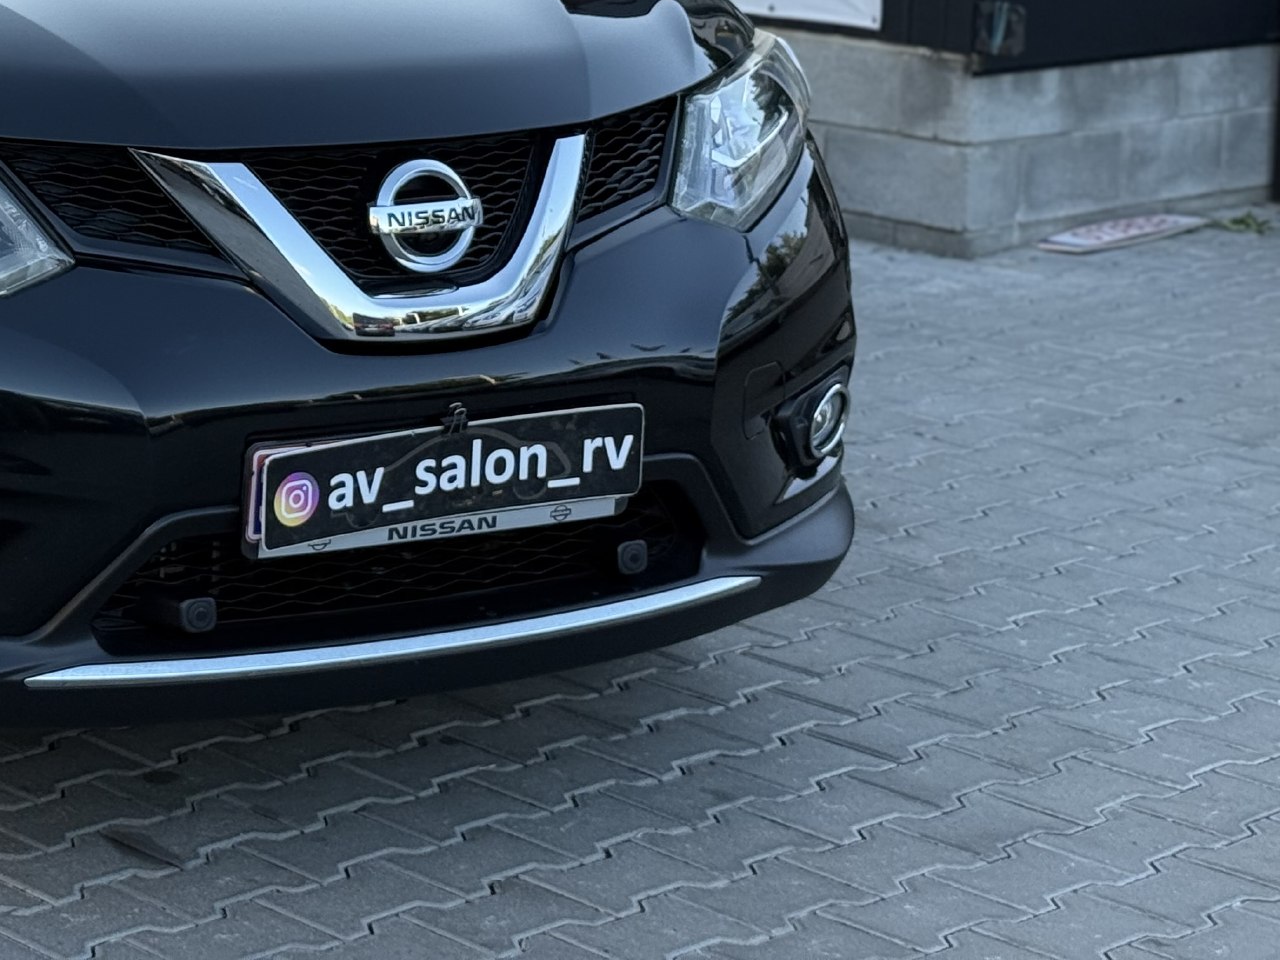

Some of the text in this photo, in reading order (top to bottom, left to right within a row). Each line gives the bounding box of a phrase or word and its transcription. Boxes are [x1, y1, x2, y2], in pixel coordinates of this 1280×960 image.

[387, 206, 475, 228] NISSAN
[328, 434, 634, 513] av_salon_rv
[387, 515, 498, 541] NISSAN
